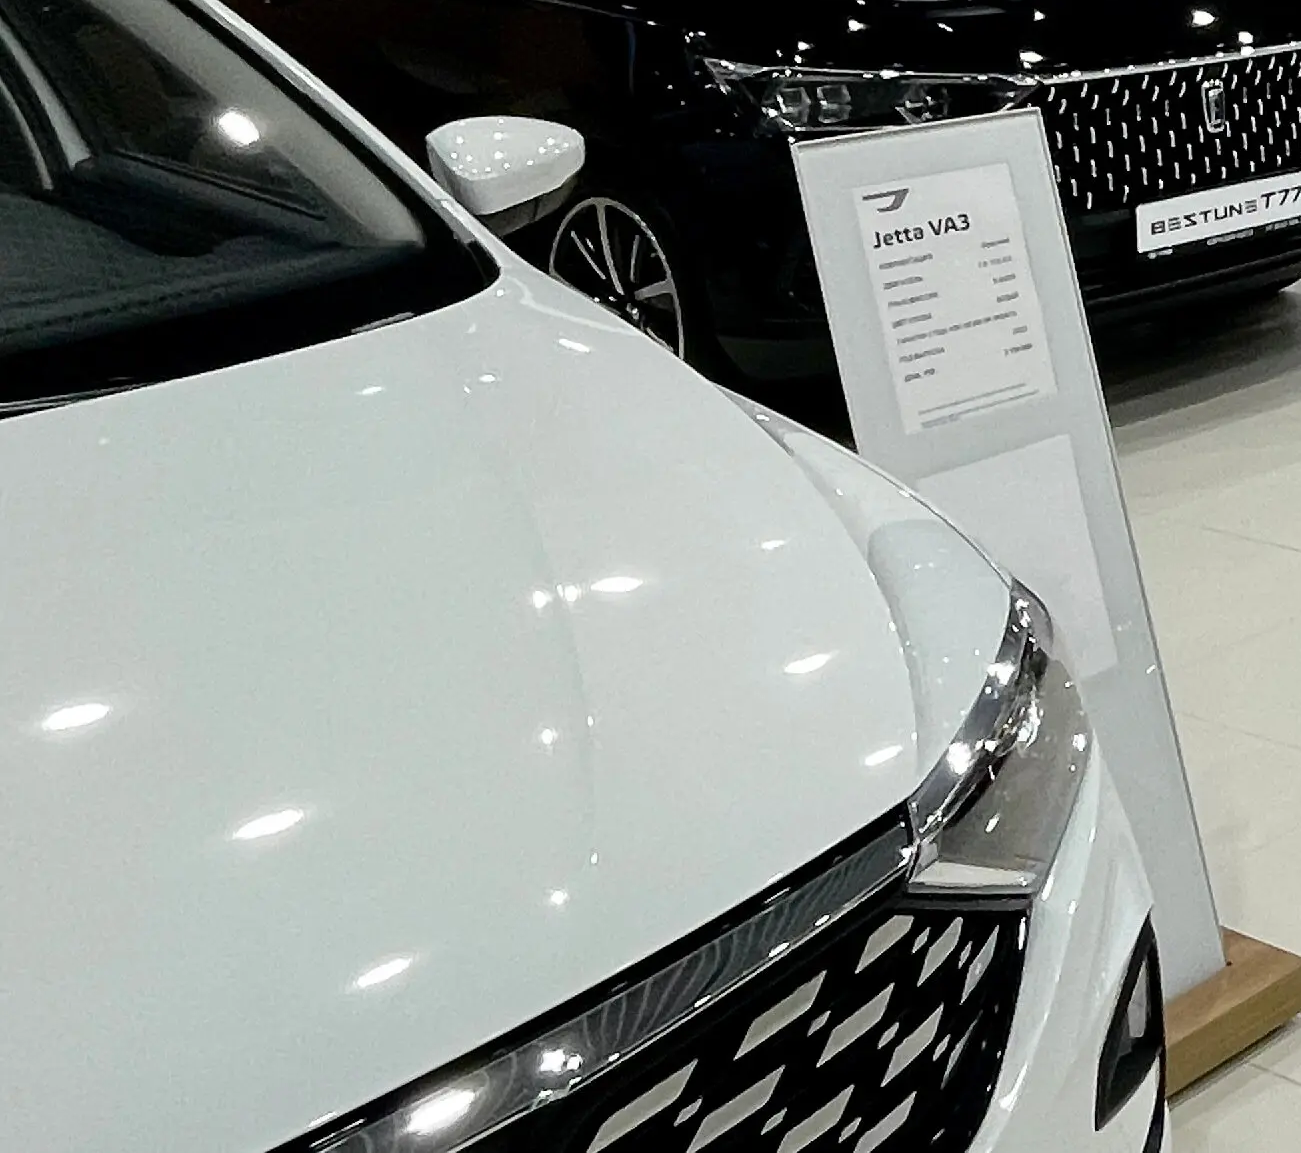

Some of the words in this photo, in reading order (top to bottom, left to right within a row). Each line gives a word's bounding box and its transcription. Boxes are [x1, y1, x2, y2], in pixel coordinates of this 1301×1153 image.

[873, 226, 924, 249] Jetta
[928, 213, 971, 236] VA3
[1151, 199, 1258, 236] BESTUNE
